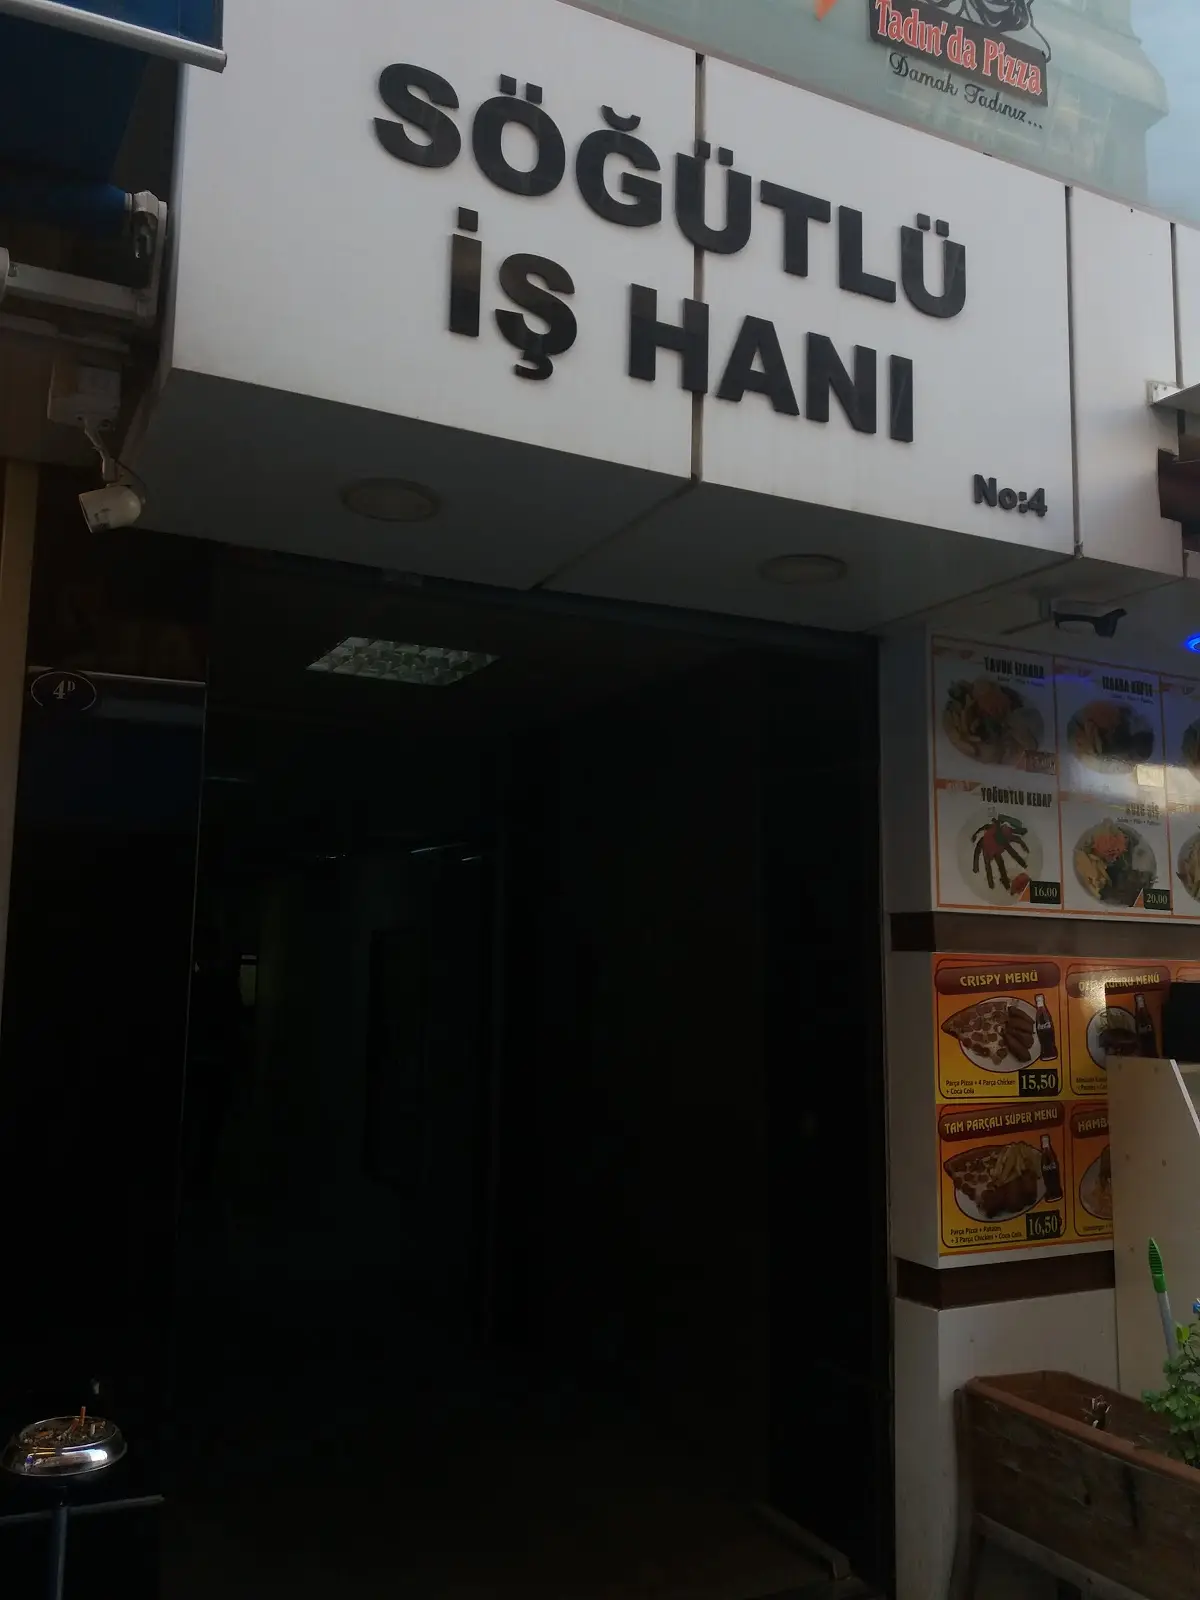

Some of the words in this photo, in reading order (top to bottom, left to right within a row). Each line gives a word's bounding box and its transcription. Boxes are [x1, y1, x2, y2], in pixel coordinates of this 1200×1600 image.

[889, 51, 958, 96] Damak
[983, 37, 1042, 95] Pizza
[373, 62, 967, 319] SÖĞÜTLÜ
[447, 206, 578, 381] İŞ
[628, 282, 914, 443] HANI
[972, 473, 1048, 517] No:4
[981, 785, 1025, 805] YOĞURTLU
[1026, 791, 1053, 808] KEBAP
[959, 973, 1001, 987] CRISPY
[1005, 969, 1039, 984] MENÜ
[1020, 1074, 1056, 1092] 15,50
[944, 1120, 964, 1135] TAM
[966, 1117, 1003, 1132] PARÇALI
[1078, 1117, 1109, 1132] HAMB
[1029, 1214, 1058, 1237] 16,50
